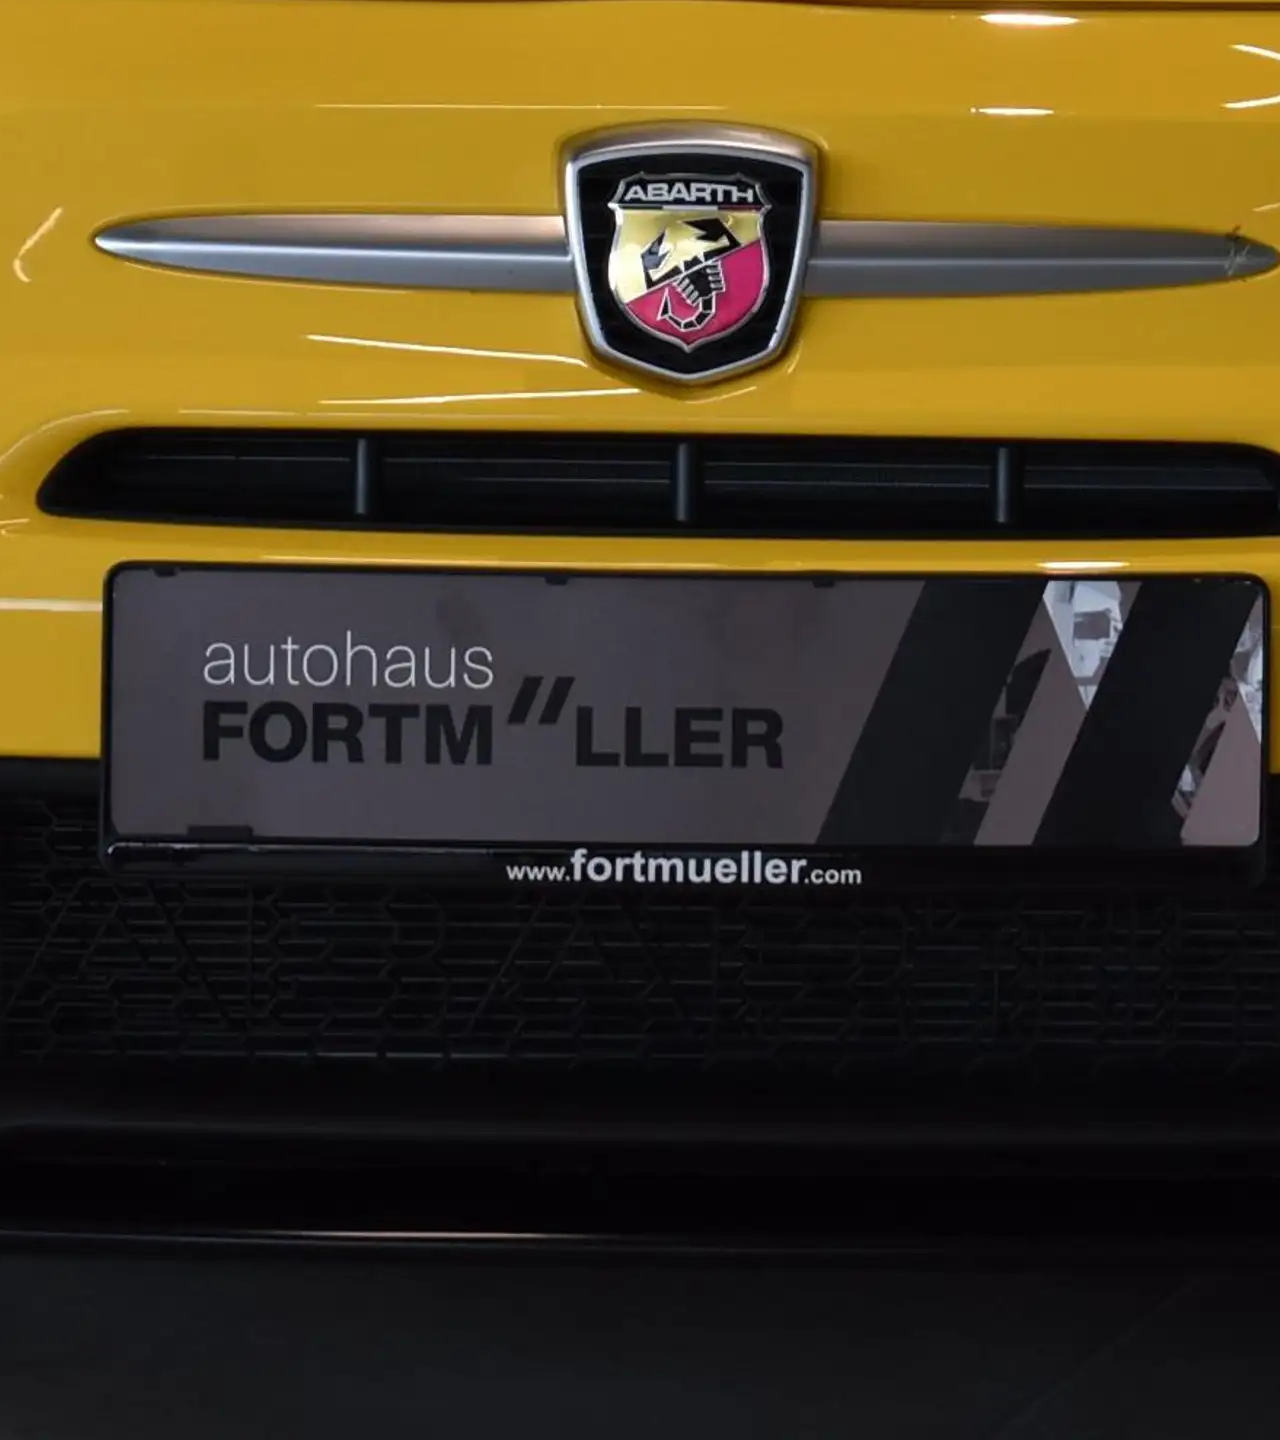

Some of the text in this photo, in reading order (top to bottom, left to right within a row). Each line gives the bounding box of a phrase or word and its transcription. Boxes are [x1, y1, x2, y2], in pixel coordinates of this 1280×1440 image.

[624, 182, 754, 203] ABARTH
[203, 630, 495, 690] autohaus
[505, 847, 863, 885] www.fortmueller.com
